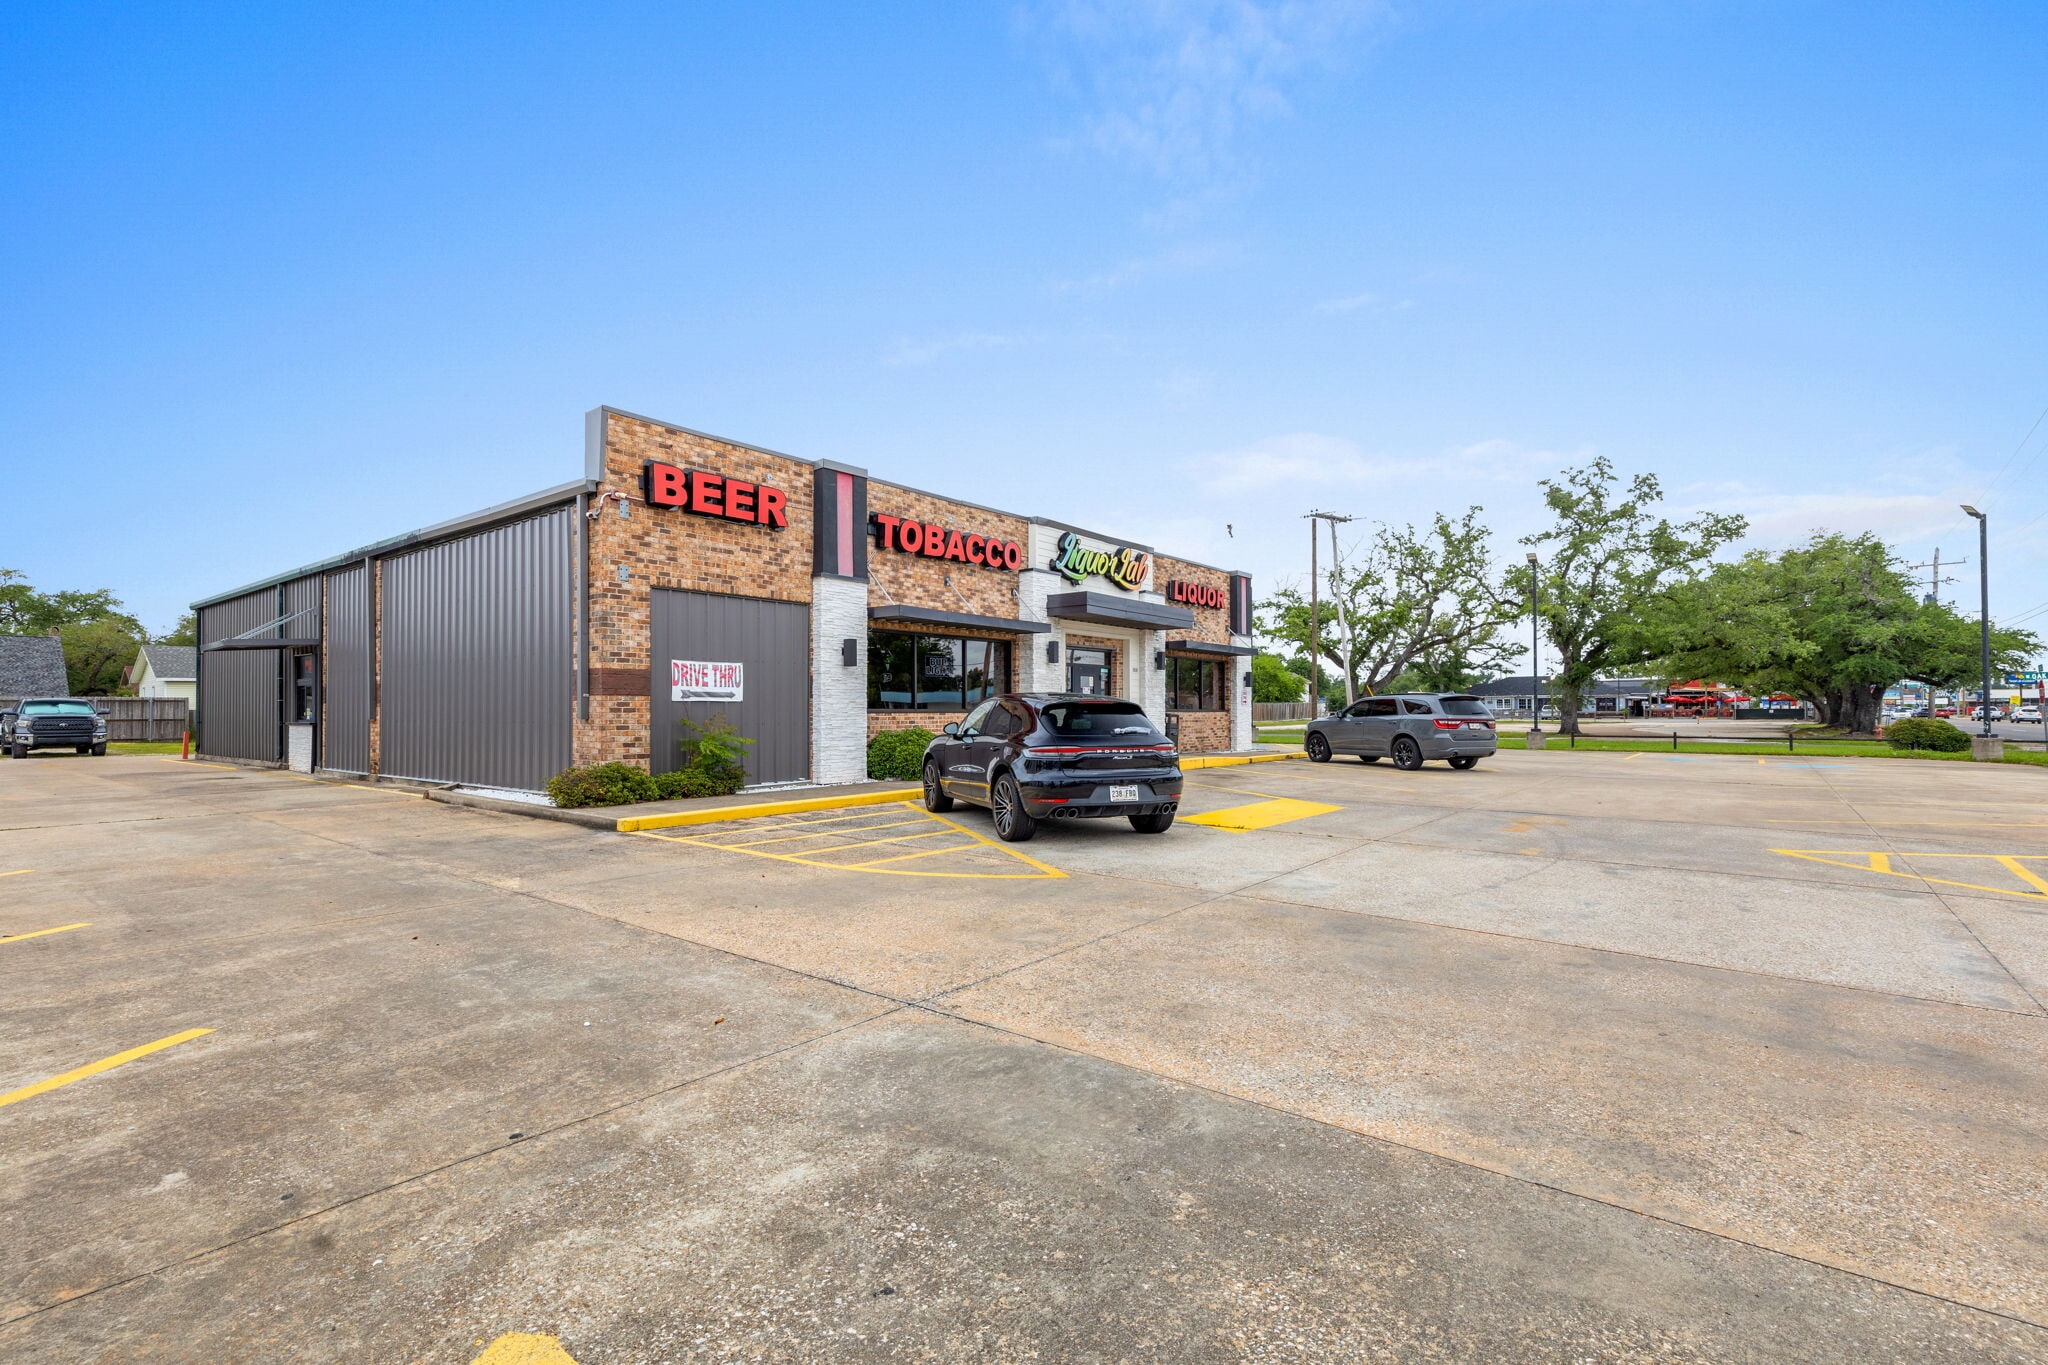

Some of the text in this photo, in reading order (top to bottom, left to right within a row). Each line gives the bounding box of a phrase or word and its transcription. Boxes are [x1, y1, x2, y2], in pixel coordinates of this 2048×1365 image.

[651, 462, 789, 527] BEER
[877, 513, 1022, 570] TOBACCO
[1055, 532, 1149, 591] Liquor Lab
[1173, 580, 1226, 609] LIQUOR
[672, 662, 742, 688] DRIVE THRU
